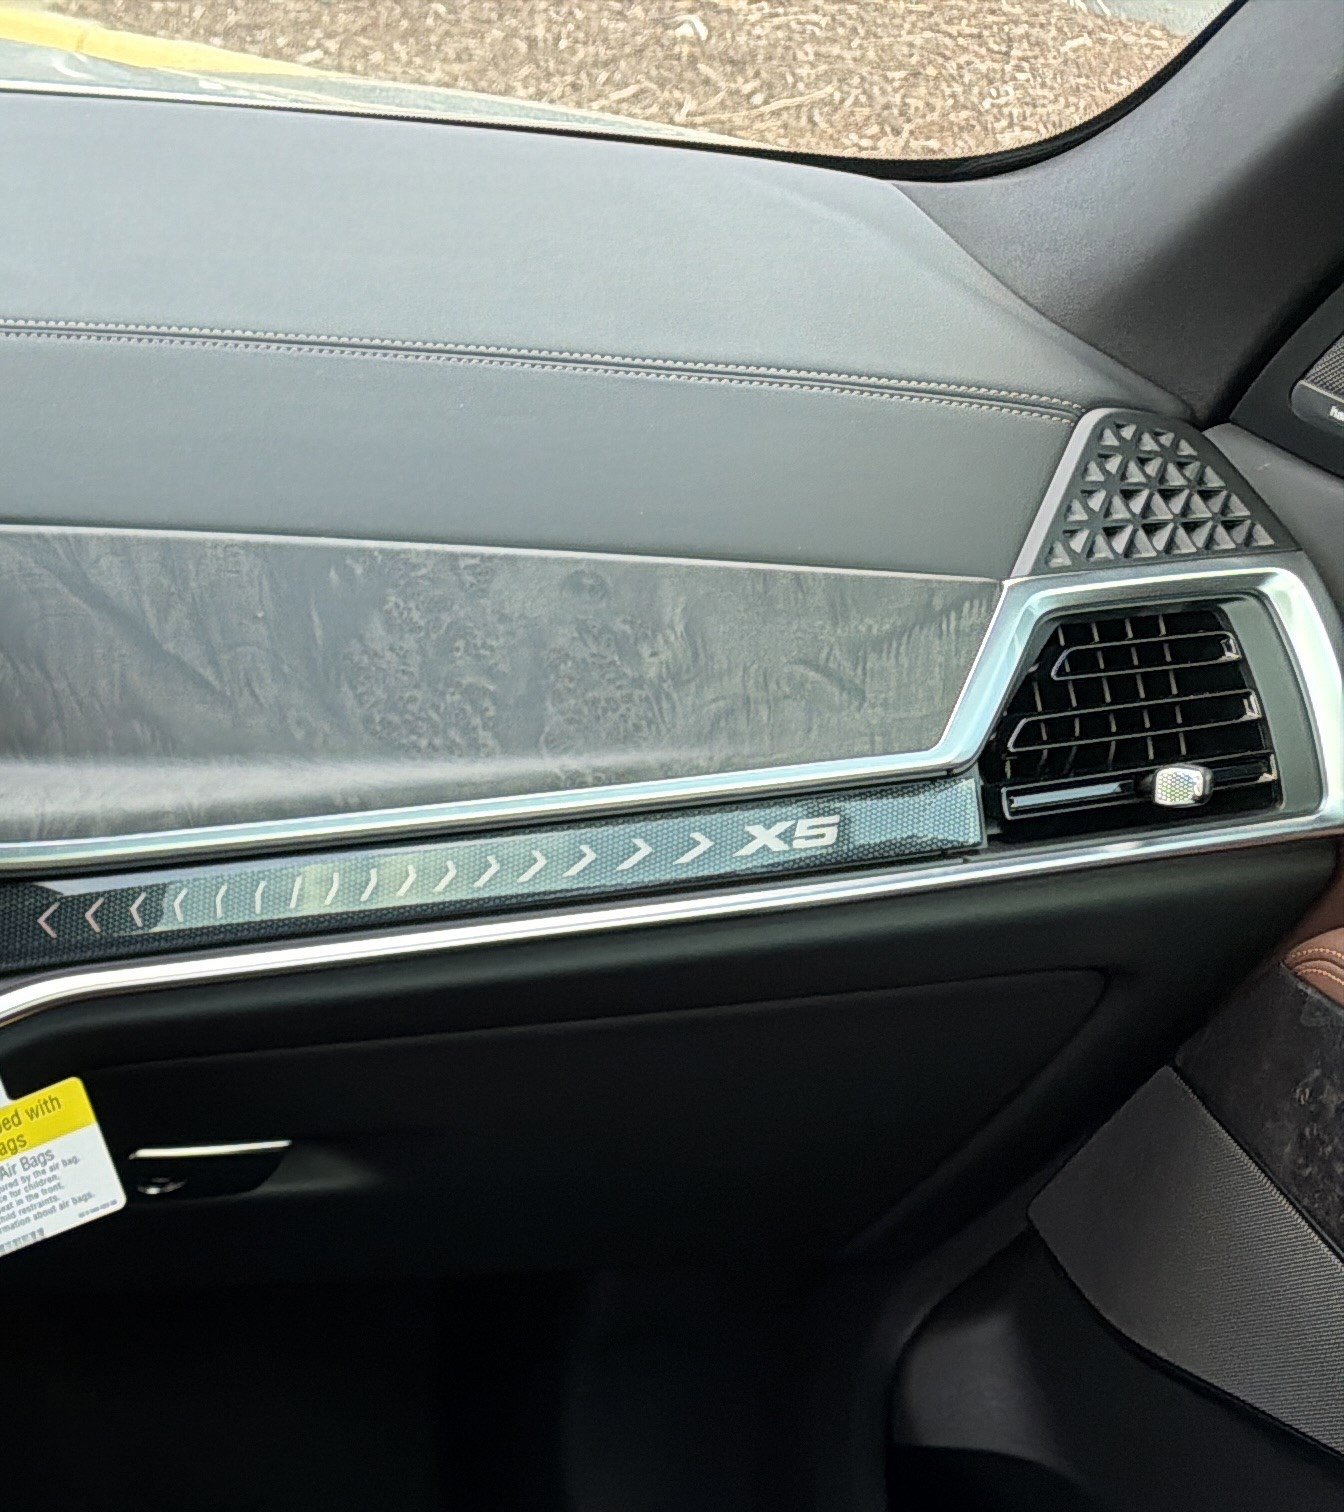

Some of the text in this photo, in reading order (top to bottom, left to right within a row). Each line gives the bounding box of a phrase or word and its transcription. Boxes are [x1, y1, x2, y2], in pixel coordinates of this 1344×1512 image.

[732, 814, 840, 857] X5
[24, 1094, 63, 1122] with
[0, 1163, 16, 1180] Air
[19, 1149, 55, 1172] Bags
